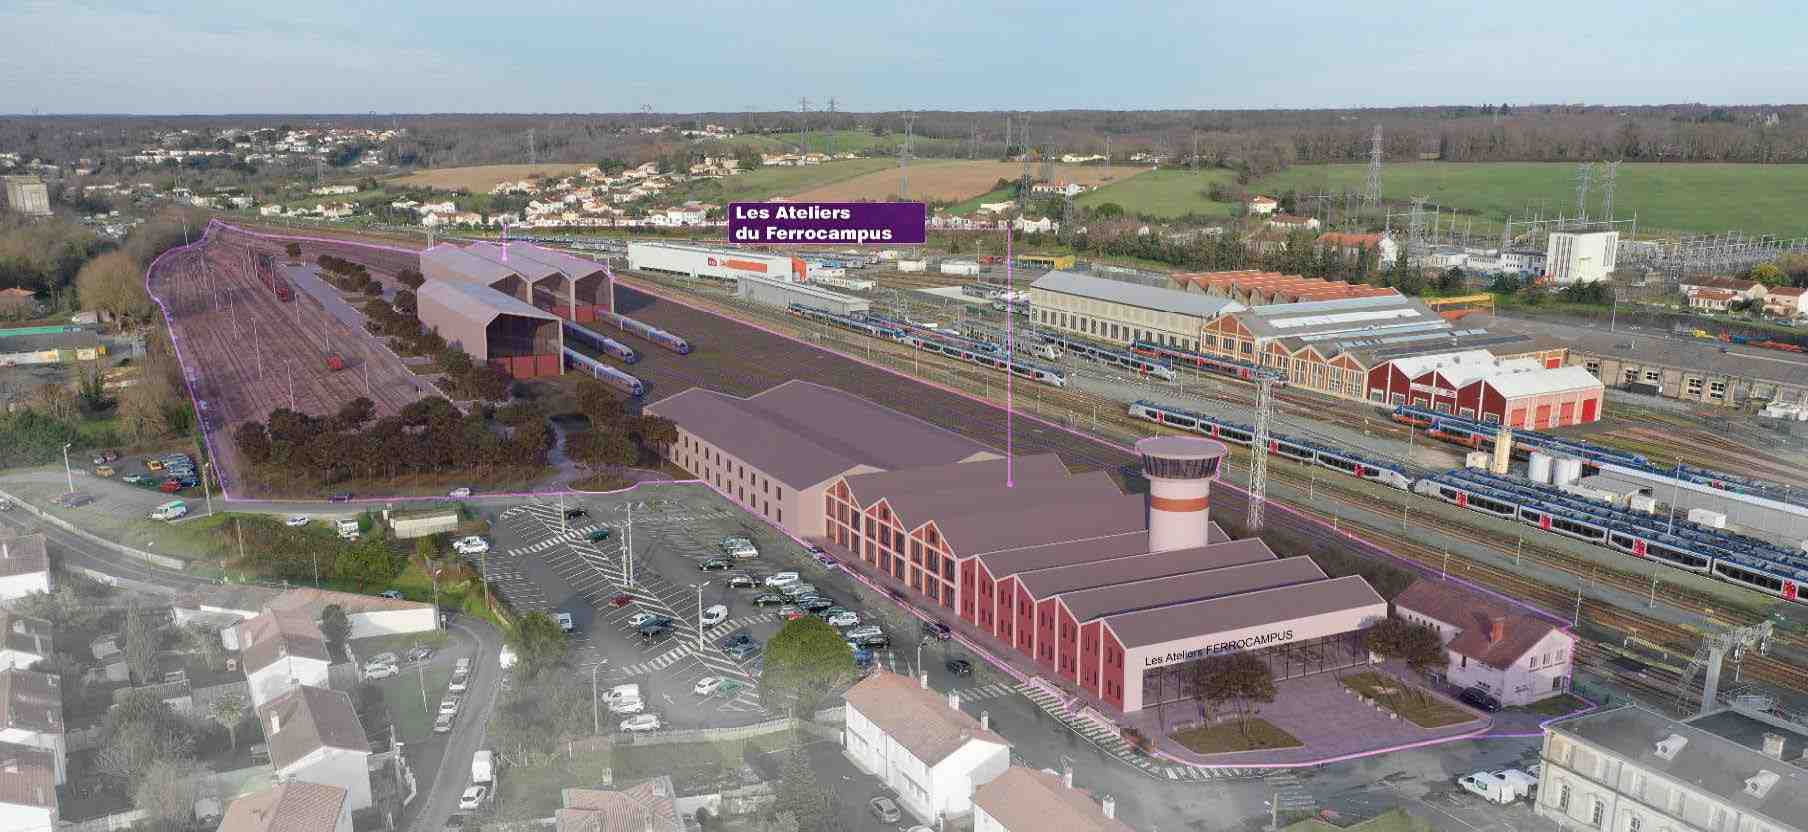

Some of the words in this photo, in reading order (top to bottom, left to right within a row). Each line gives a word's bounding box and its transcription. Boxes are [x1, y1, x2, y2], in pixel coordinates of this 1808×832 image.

[1144, 655, 1163, 666] Les
[1165, 648, 1202, 662] Ateliers
[1206, 630, 1294, 655] FERROCAMPUS
